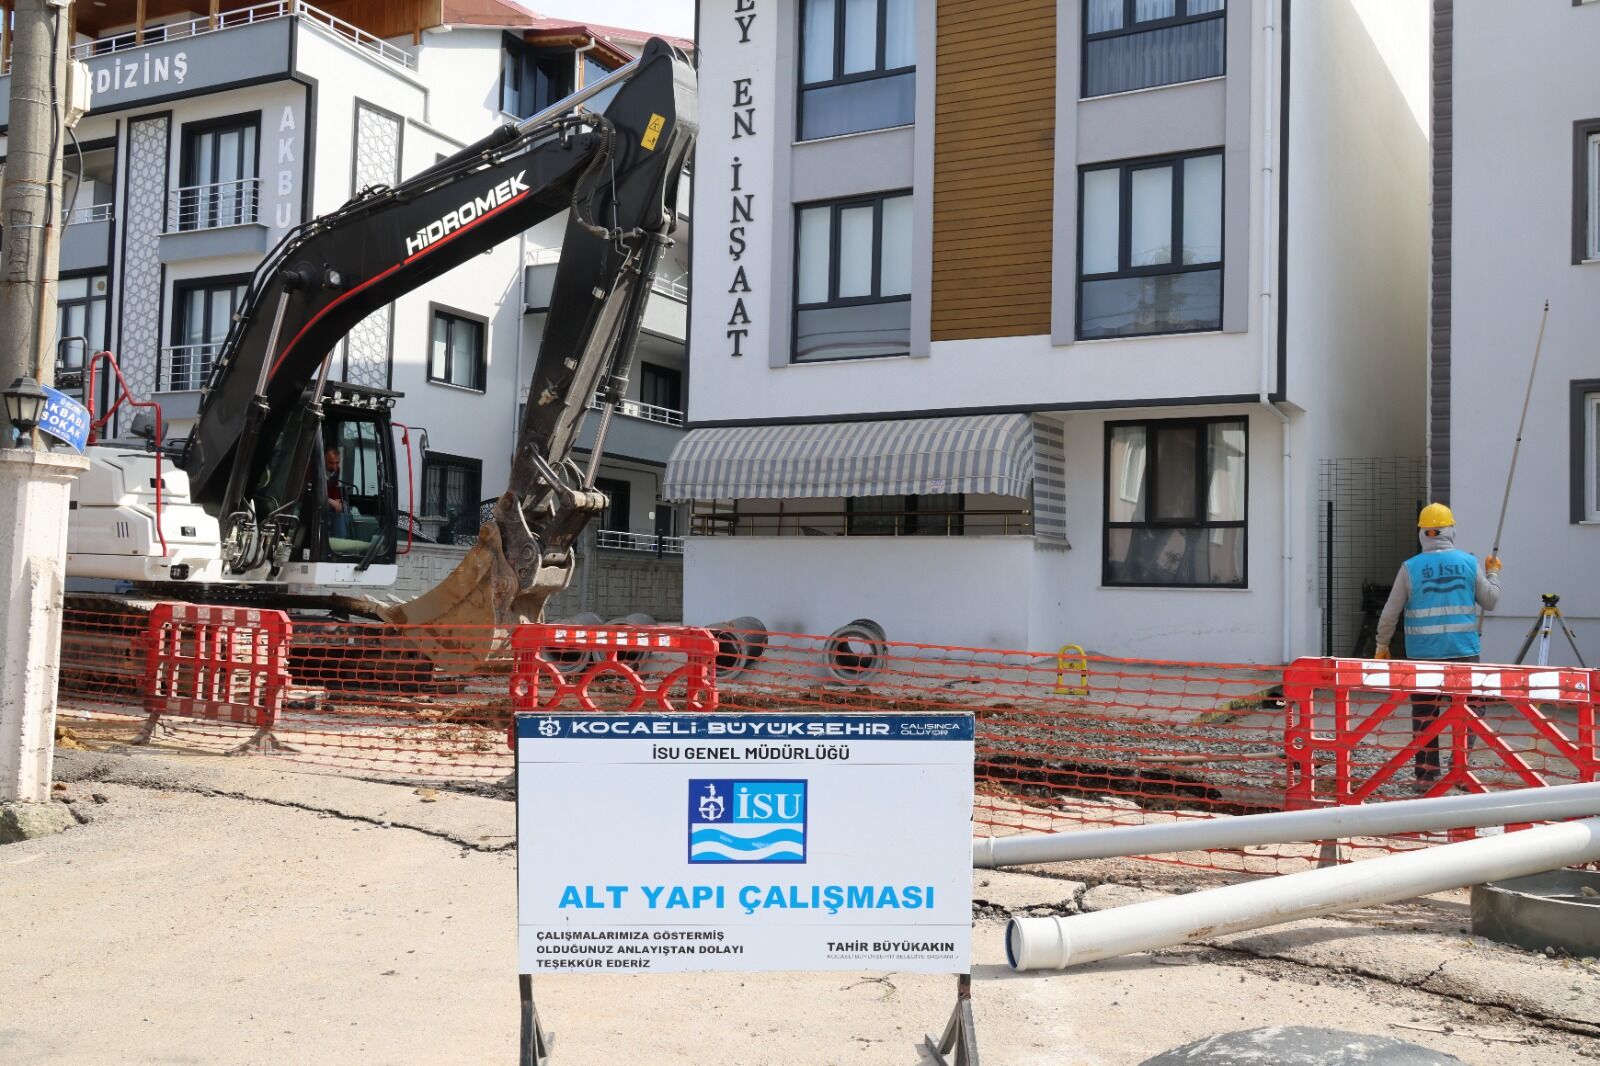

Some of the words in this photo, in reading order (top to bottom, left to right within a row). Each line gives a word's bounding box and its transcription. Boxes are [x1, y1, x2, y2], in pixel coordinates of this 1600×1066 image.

[90, 52, 187, 95] DİZİNŞ
[731, 78, 757, 139] EN
[275, 106, 296, 254] AKBU
[727, 157, 755, 357] İNŞAAT
[40, 411, 81, 439] SOKAK
[652, 744, 680, 760] İSU
[684, 746, 740, 760] GENEL
[745, 744, 850, 760] MÜDÜRLÜĞÜ
[736, 787, 803, 820] İSU
[558, 886, 628, 909] ALT
[640, 886, 725, 909] YAPI
[738, 885, 935, 915] ÇALIŞMASI
[536, 931, 649, 941] ÇALIŞMALARIMIZA
[653, 929, 725, 941] GÖSTERMİŞ
[827, 940, 869, 952] TAHİR
[873, 940, 955, 952] BÜYÜKAKIN
[536, 944, 613, 954] OLDUĞUNUZ
[617, 945, 695, 956] ANLAYIŞTAN
[699, 945, 744, 954] DOLAYI
[536, 958, 602, 969] TEŞEKKÜR
[606, 957, 650, 968] EDERİZ
